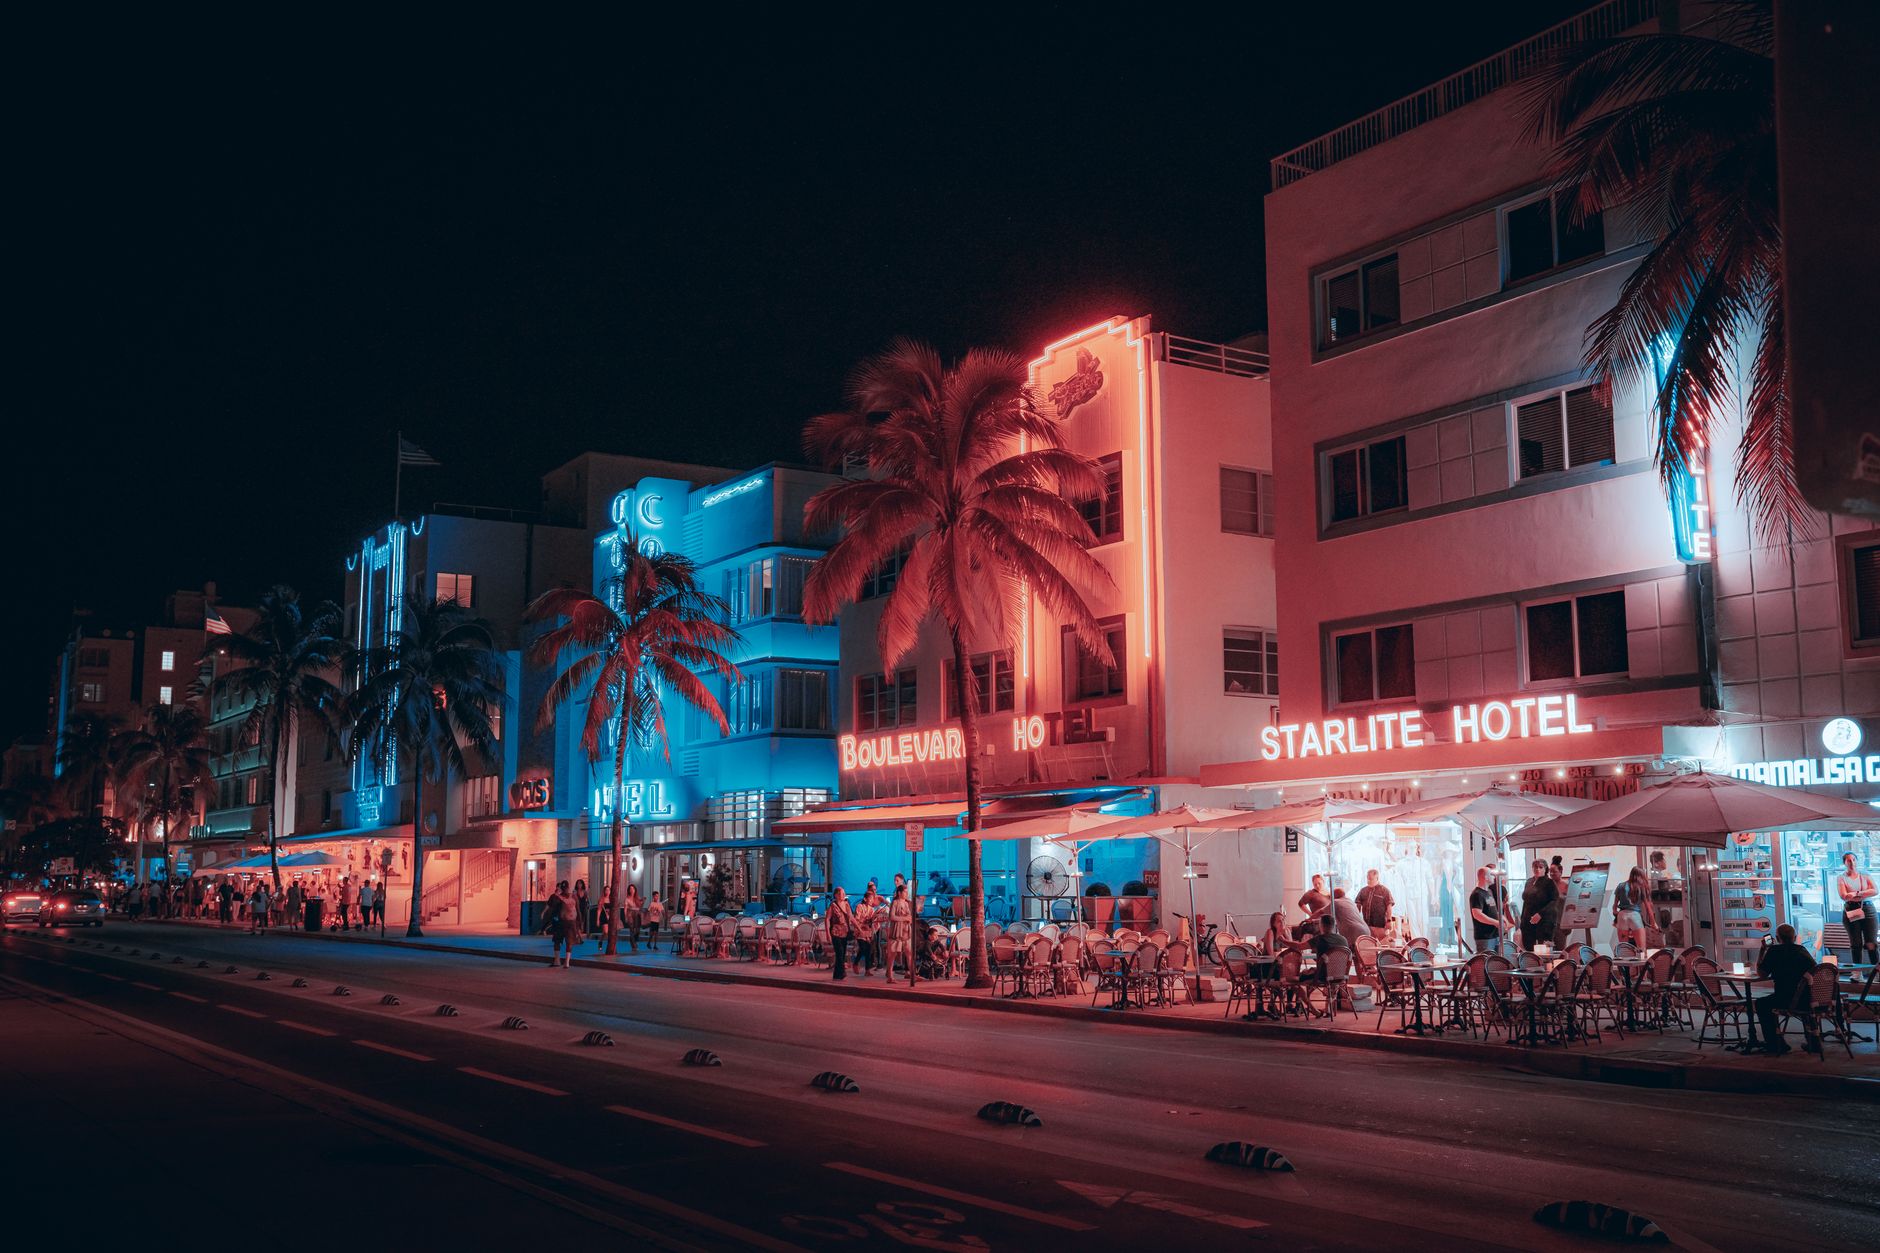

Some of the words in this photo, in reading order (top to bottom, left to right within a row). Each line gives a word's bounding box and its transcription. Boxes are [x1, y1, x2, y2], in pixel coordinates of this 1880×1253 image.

[840, 727, 966, 770] BOULEVAR
[1013, 706, 1108, 752] HOTEL
[1260, 709, 1424, 761] STARLITE
[1452, 693, 1593, 744] HOTEL
[1567, 766, 1593, 778] CAFE
[1731, 756, 1863, 787] MAMALISA
[522, 777, 550, 805] CVS
[1144, 873, 1159, 885] FDC
